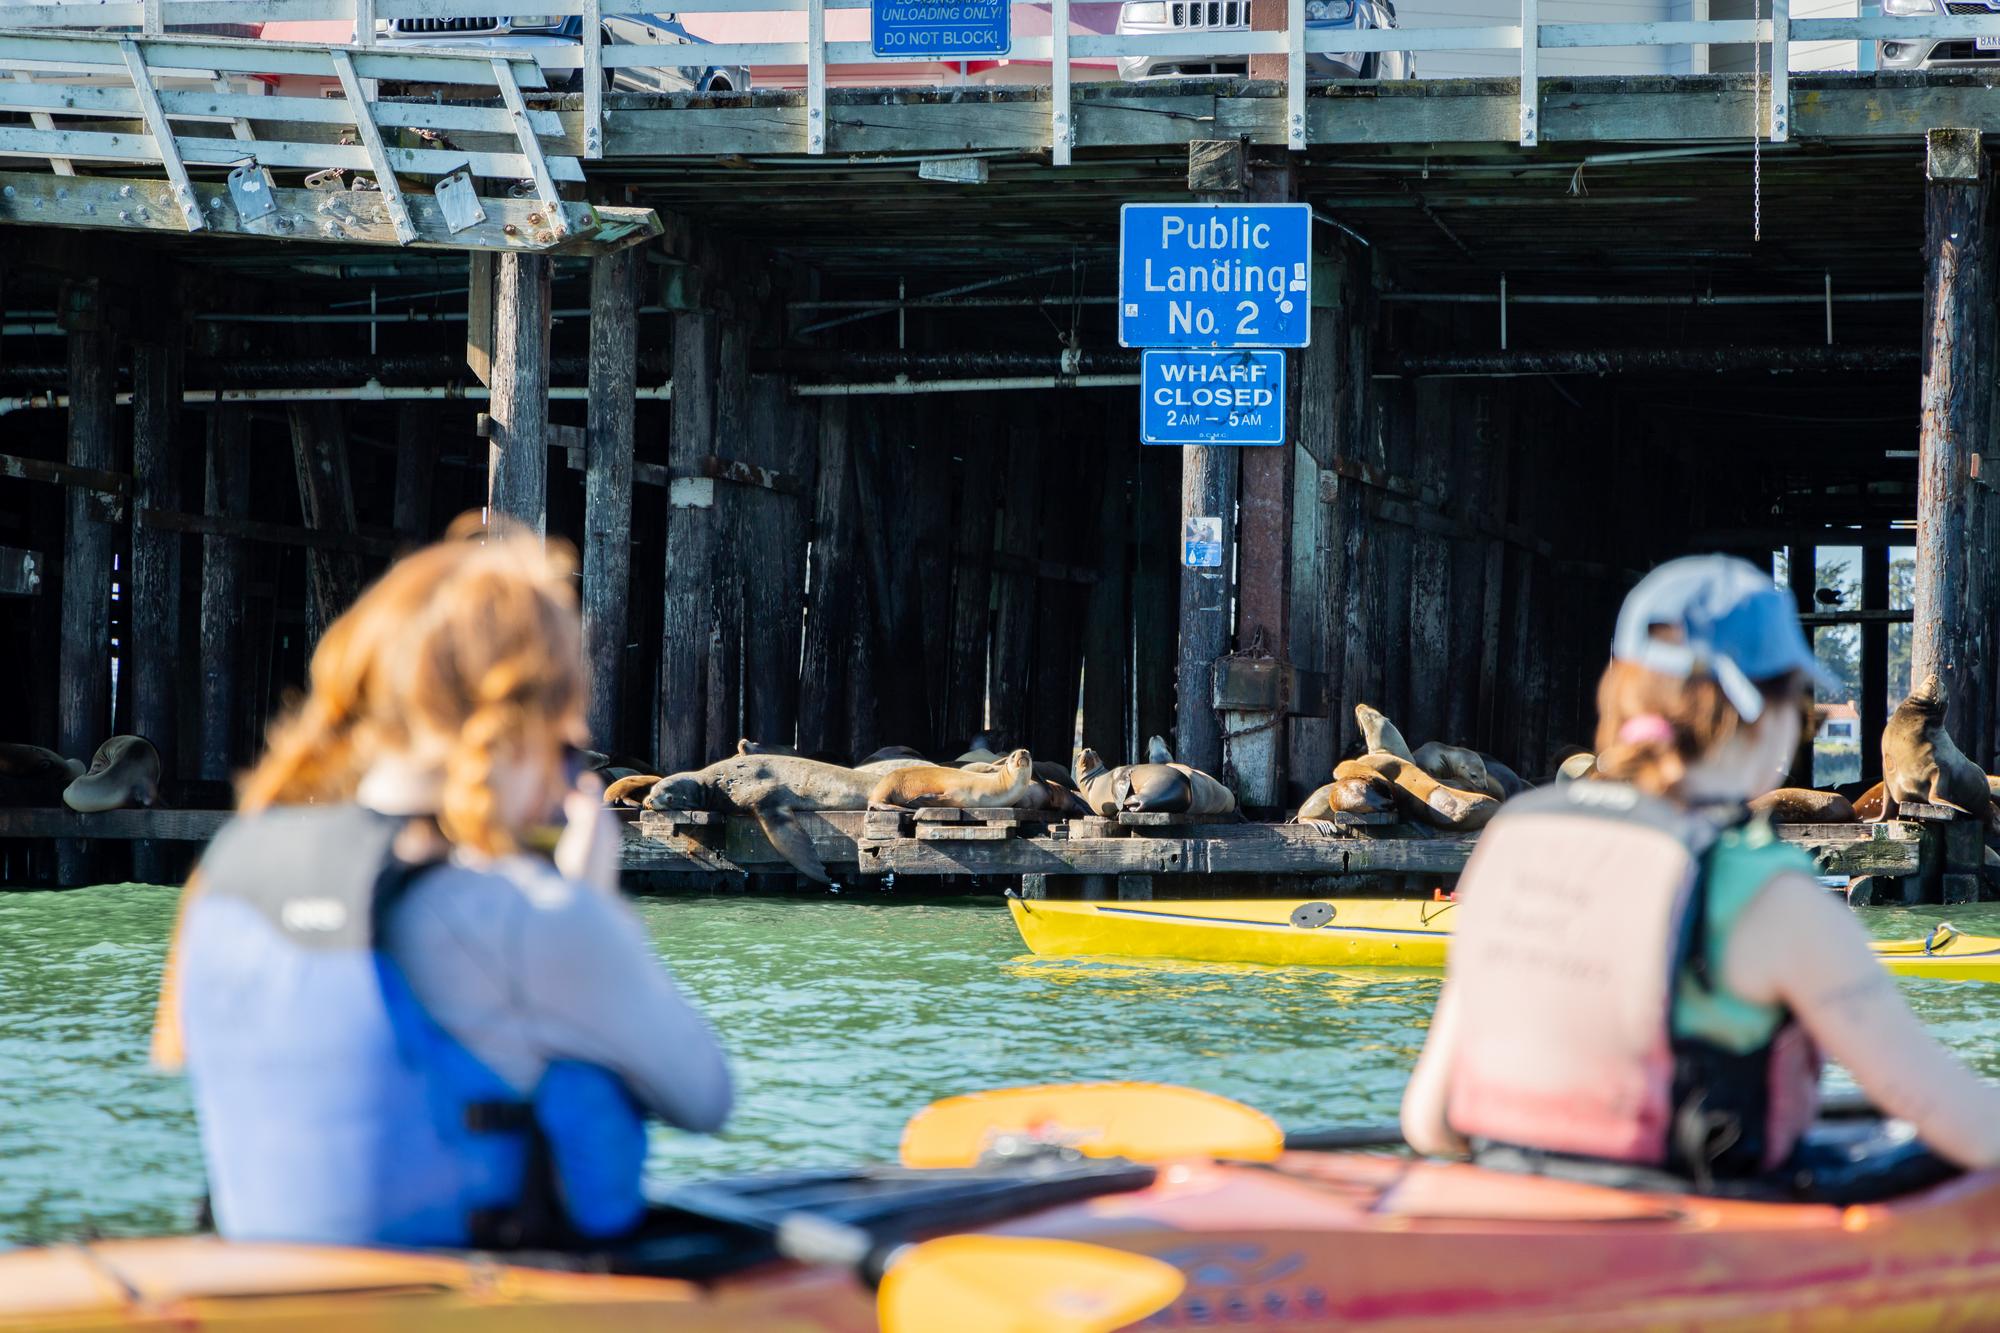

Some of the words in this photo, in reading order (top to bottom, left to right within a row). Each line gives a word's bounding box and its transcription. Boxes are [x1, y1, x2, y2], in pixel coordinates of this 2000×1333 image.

[882, 8, 960, 21] UNLOADING
[884, 32, 905, 46] DO
[909, 32, 940, 45] NOT
[943, 31, 998, 44] BLOCK!
[1162, 216, 1270, 249] Public
[1145, 258, 1286, 304] Landing
[1169, 300, 1220, 334] No.
[1236, 300, 1259, 335] 2
[1160, 364, 1267, 382] WHARF
[1154, 387, 1273, 407] CLOSED
